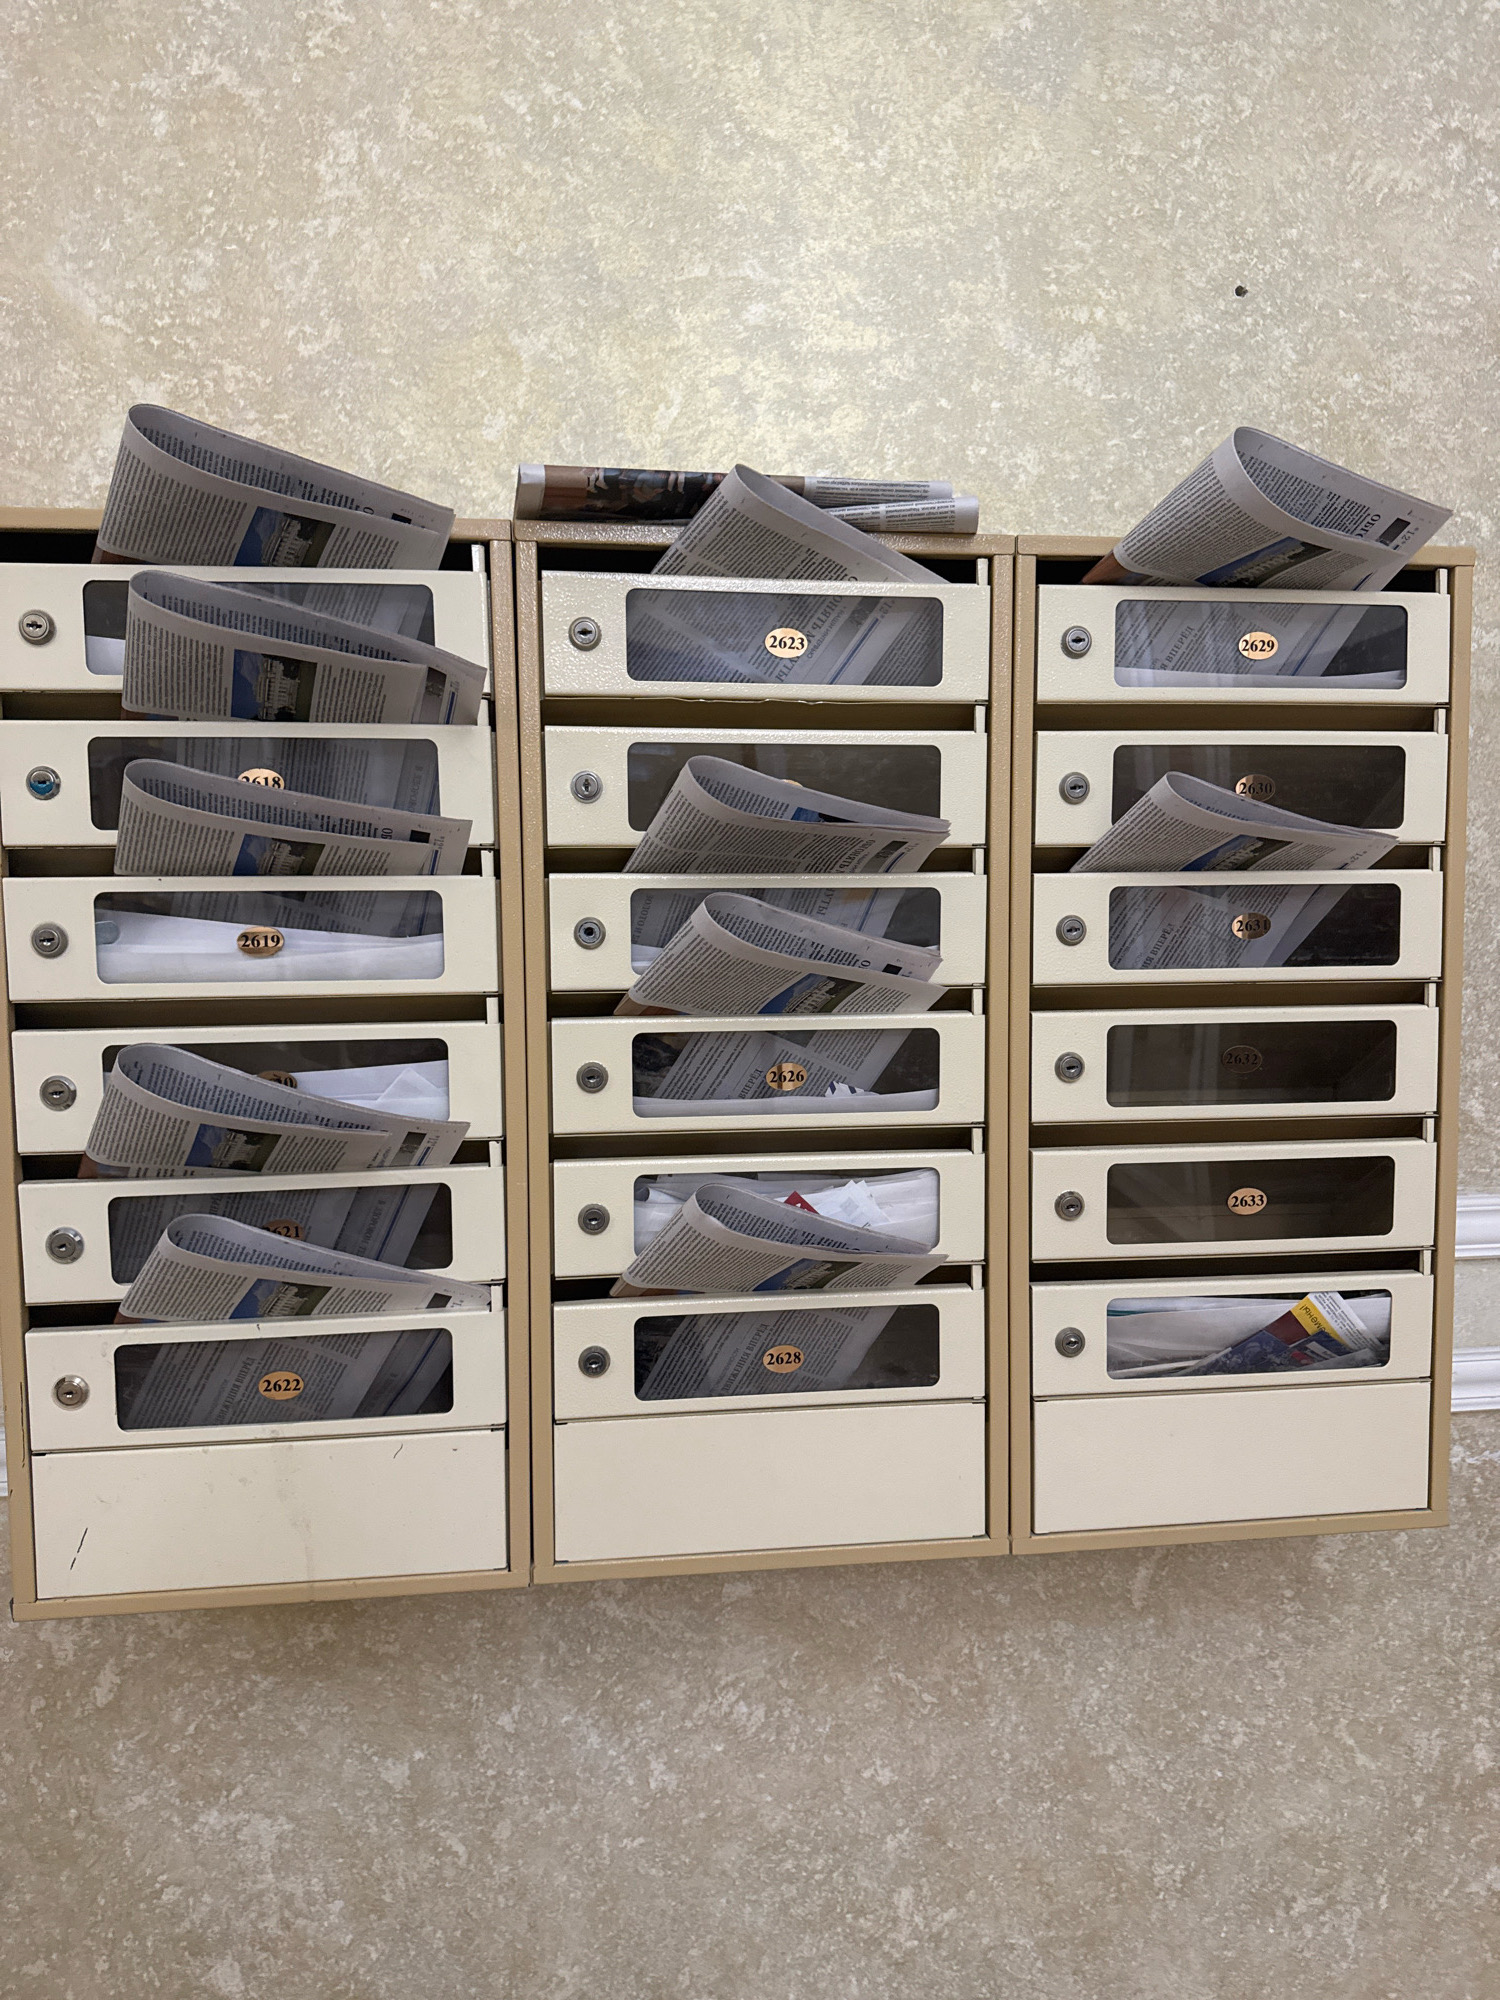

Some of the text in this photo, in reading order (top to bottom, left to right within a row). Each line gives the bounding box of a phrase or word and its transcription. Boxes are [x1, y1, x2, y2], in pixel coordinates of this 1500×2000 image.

[811, 596, 843, 635] ОНЯТЬ
[768, 635, 806, 651] 2623
[1240, 638, 1276, 653] 2629
[1239, 782, 1273, 795] 2630
[1236, 919, 1270, 932] 2631
[240, 934, 281, 948] 2619
[1225, 1052, 1258, 1065] 2632
[769, 1070, 805, 1083] 2626
[1230, 1194, 1265, 1208] 2633
[261, 1226, 300, 1238] 621
[766, 1351, 802, 1366] 2628
[262, 1378, 302, 1392] 2622
